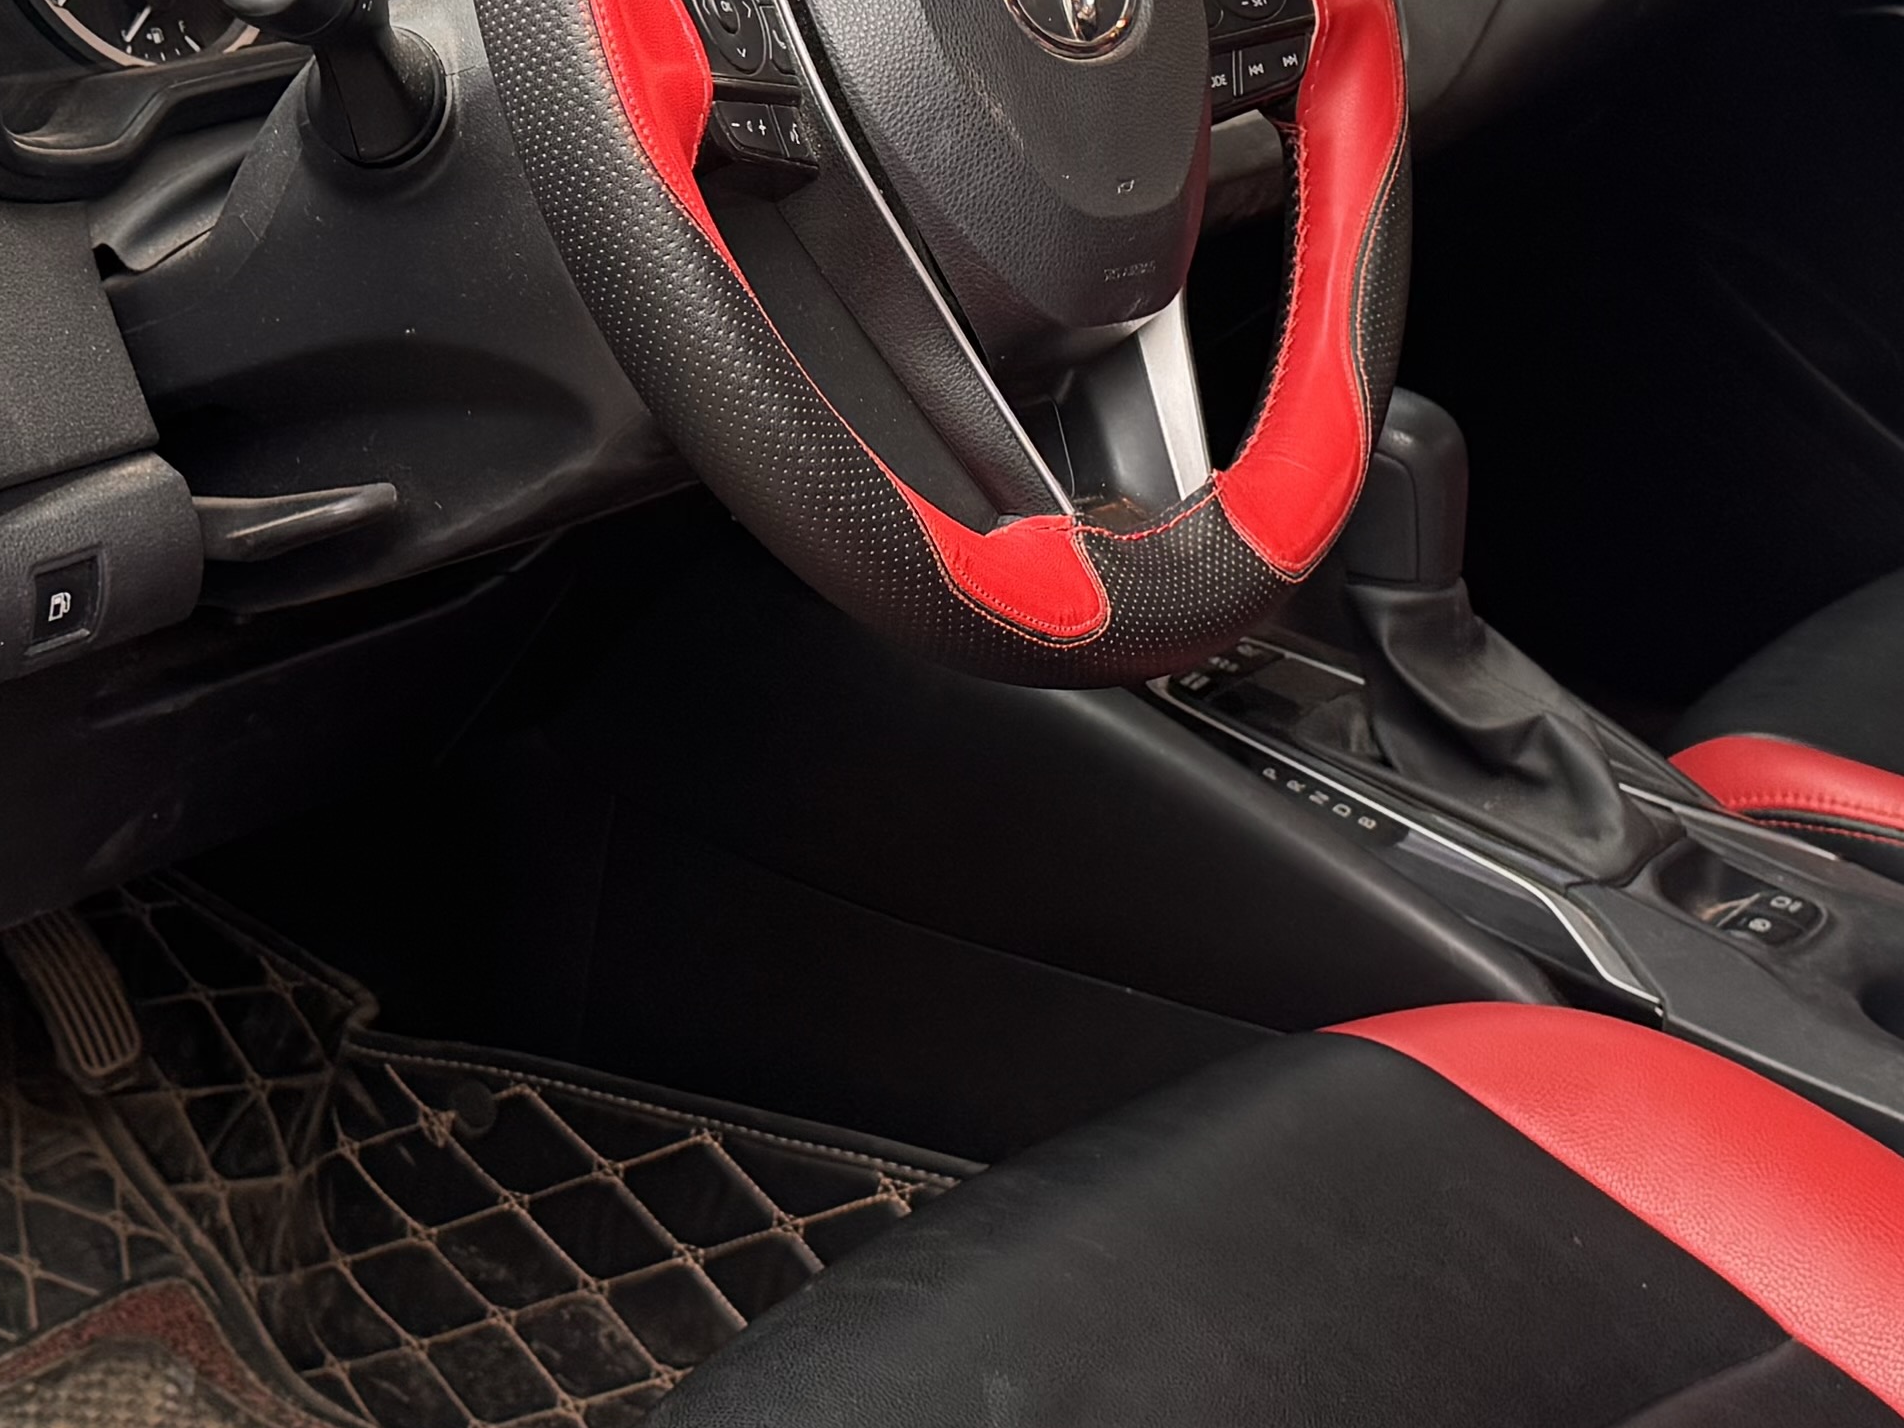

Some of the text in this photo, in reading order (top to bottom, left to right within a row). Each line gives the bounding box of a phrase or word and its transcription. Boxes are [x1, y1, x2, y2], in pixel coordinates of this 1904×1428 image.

[1262, 767, 1277, 781] P
[1286, 779, 1306, 793] R
[1308, 790, 1330, 806] N
[1332, 803, 1352, 818] D
